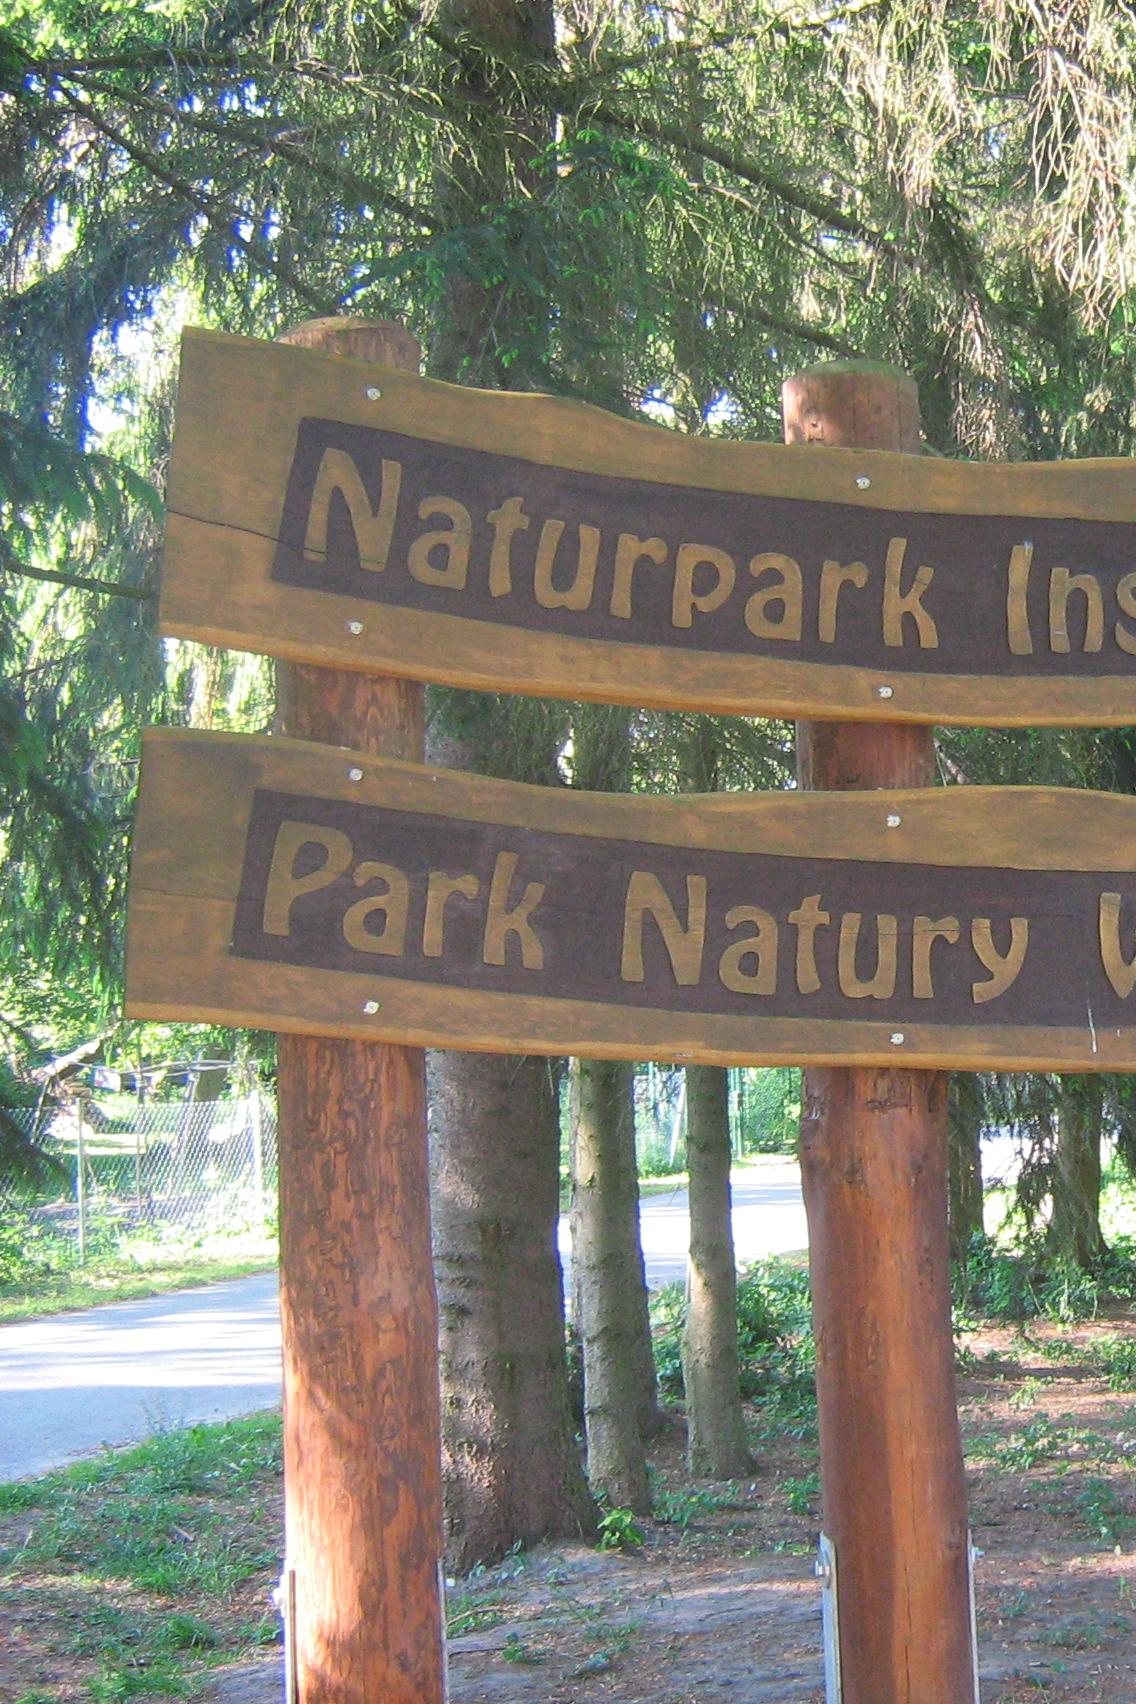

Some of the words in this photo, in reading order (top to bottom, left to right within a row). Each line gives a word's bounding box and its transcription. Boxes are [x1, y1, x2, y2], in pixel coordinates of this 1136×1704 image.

[303, 447, 939, 650] Naturpark
[263, 819, 546, 970] Park
[620, 870, 1029, 1004] Natury
